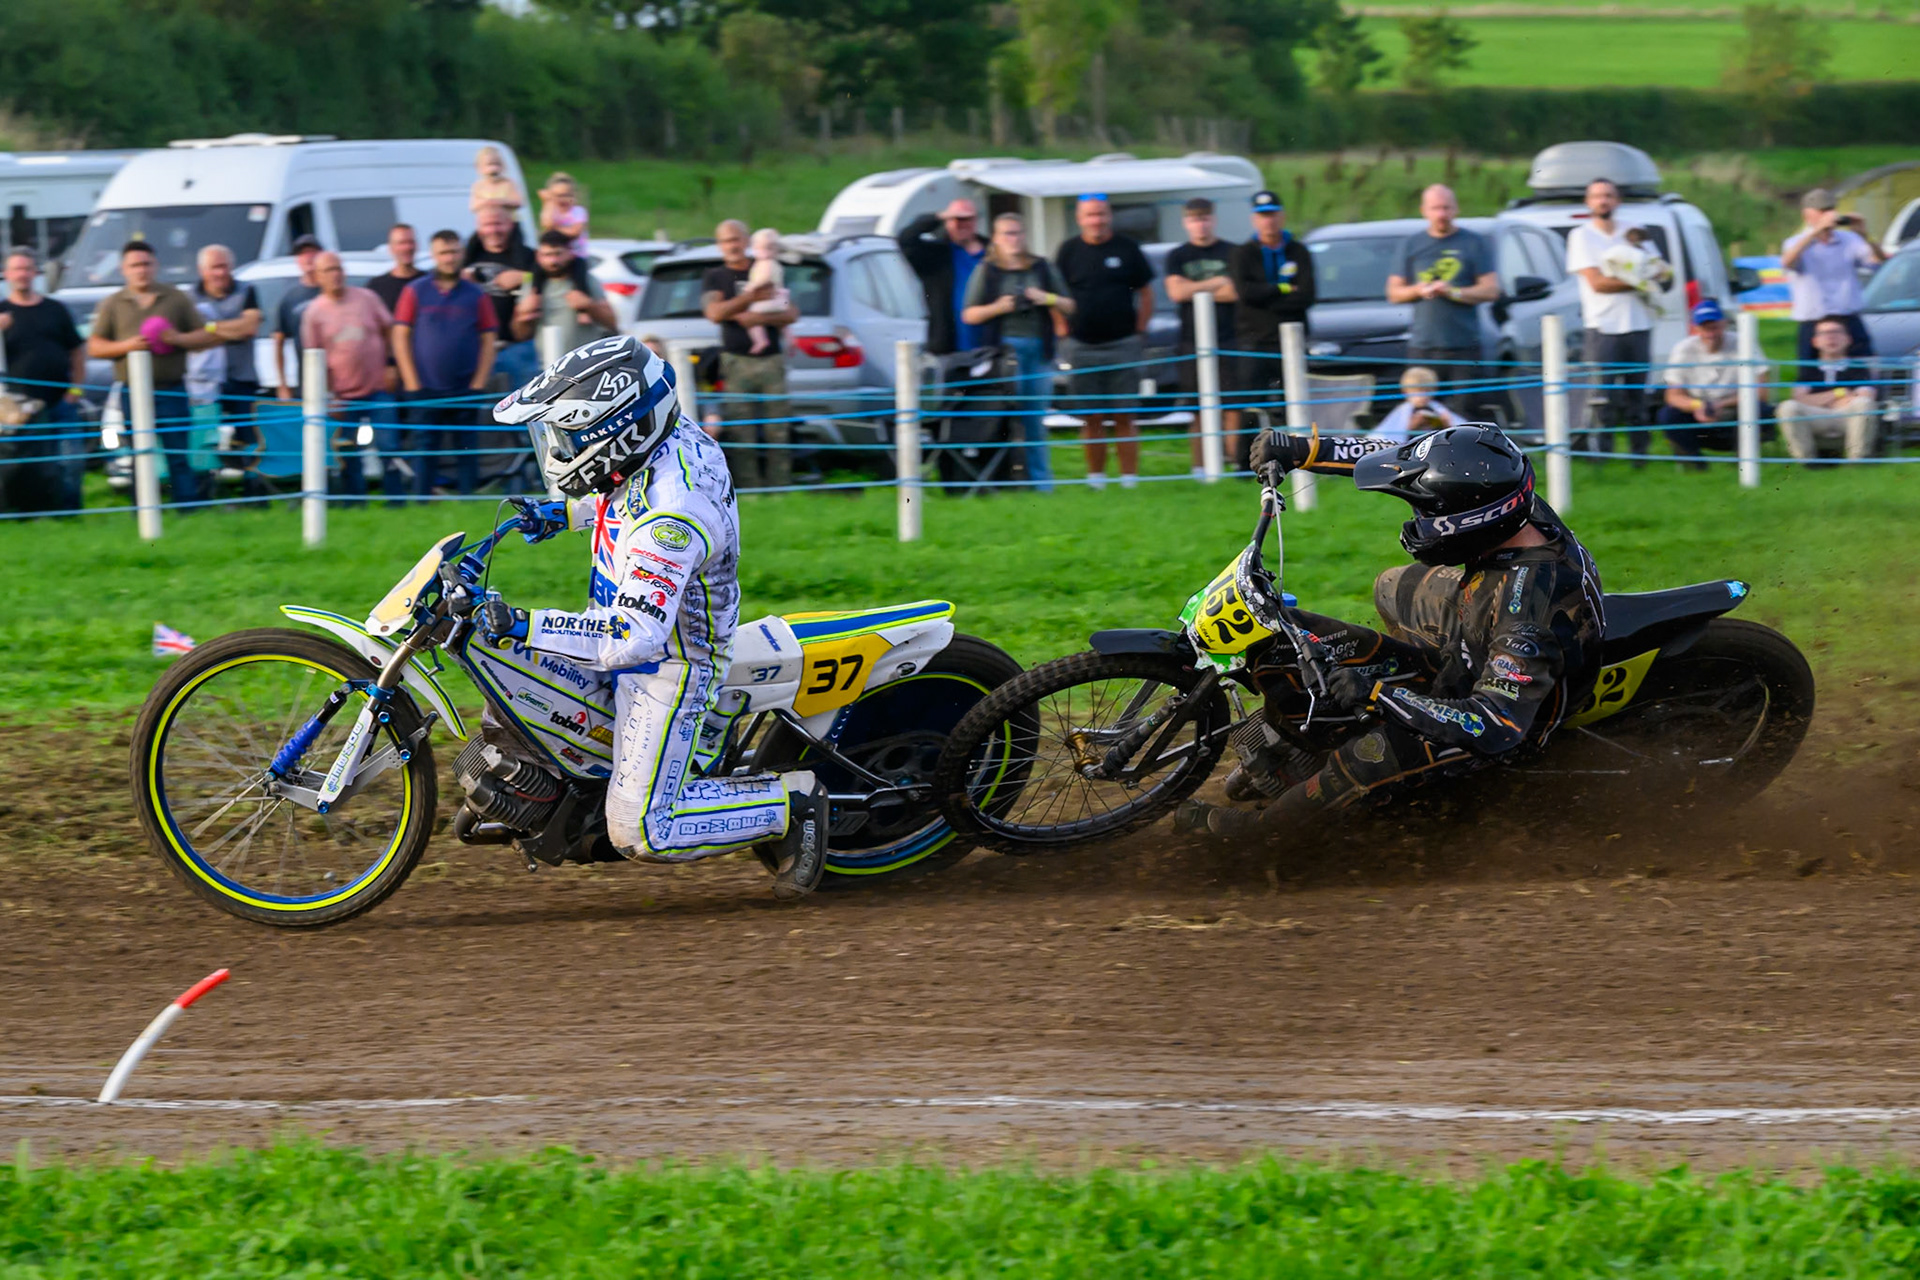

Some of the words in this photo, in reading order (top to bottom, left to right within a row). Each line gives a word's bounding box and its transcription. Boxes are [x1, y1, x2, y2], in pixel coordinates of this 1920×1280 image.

[580, 411, 635, 443] OAKLEY
[578, 421, 646, 486] FXR
[618, 591, 668, 625] tobin
[1206, 572, 1255, 645] 152
[541, 615, 611, 635] NORTHE
[540, 656, 592, 690] Mobility
[753, 665, 781, 682] 37
[807, 653, 864, 695] 37
[550, 710, 587, 736] tobin
[679, 813, 770, 836] BOMBER
